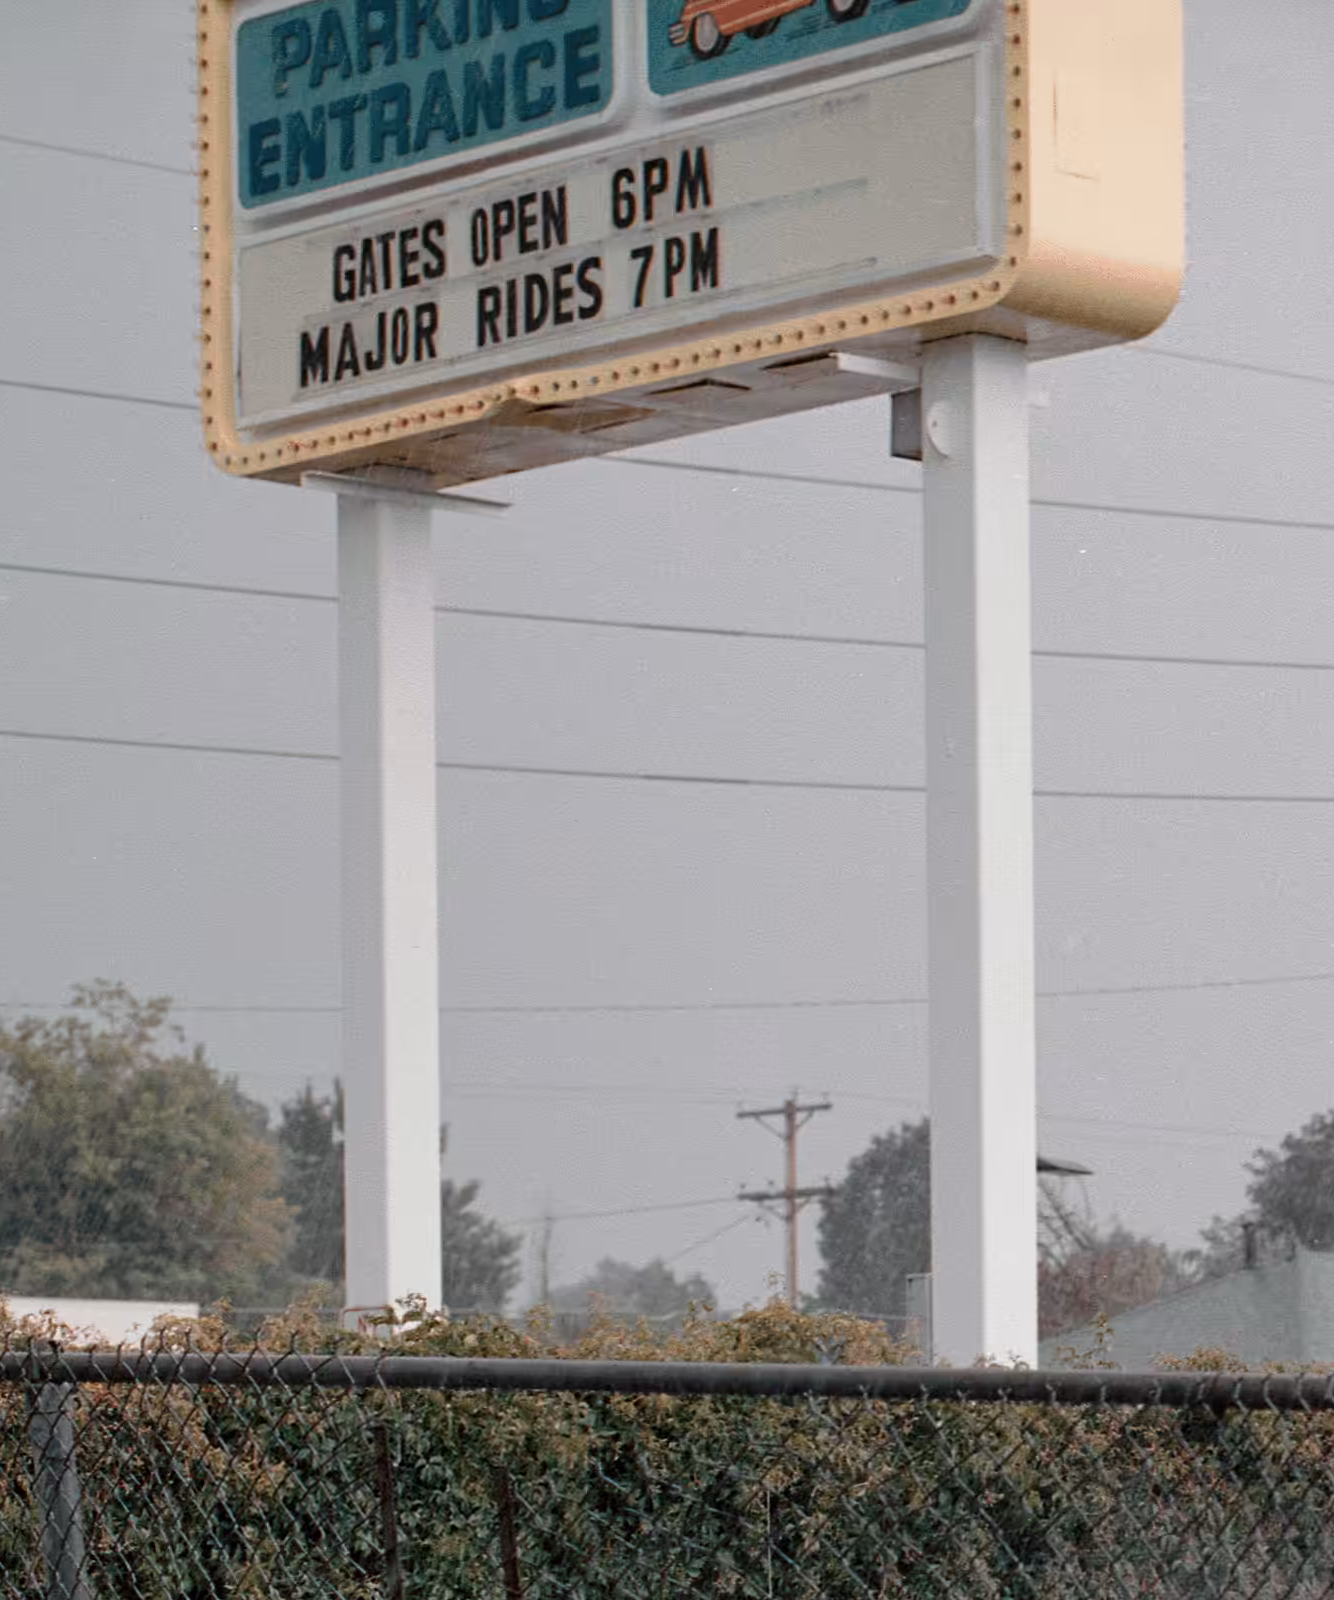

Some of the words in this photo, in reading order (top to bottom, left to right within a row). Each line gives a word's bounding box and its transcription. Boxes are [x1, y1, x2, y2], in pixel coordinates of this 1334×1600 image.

[248, 25, 602, 197] ENTRANCE
[272, 0, 568, 98] PARKI
[333, 218, 446, 303] GATES
[470, 185, 568, 267] OPEN
[611, 146, 713, 230] 6PM
[300, 302, 439, 388] MAJOR
[477, 256, 603, 347] RIDES
[630, 227, 720, 308] 7PM
